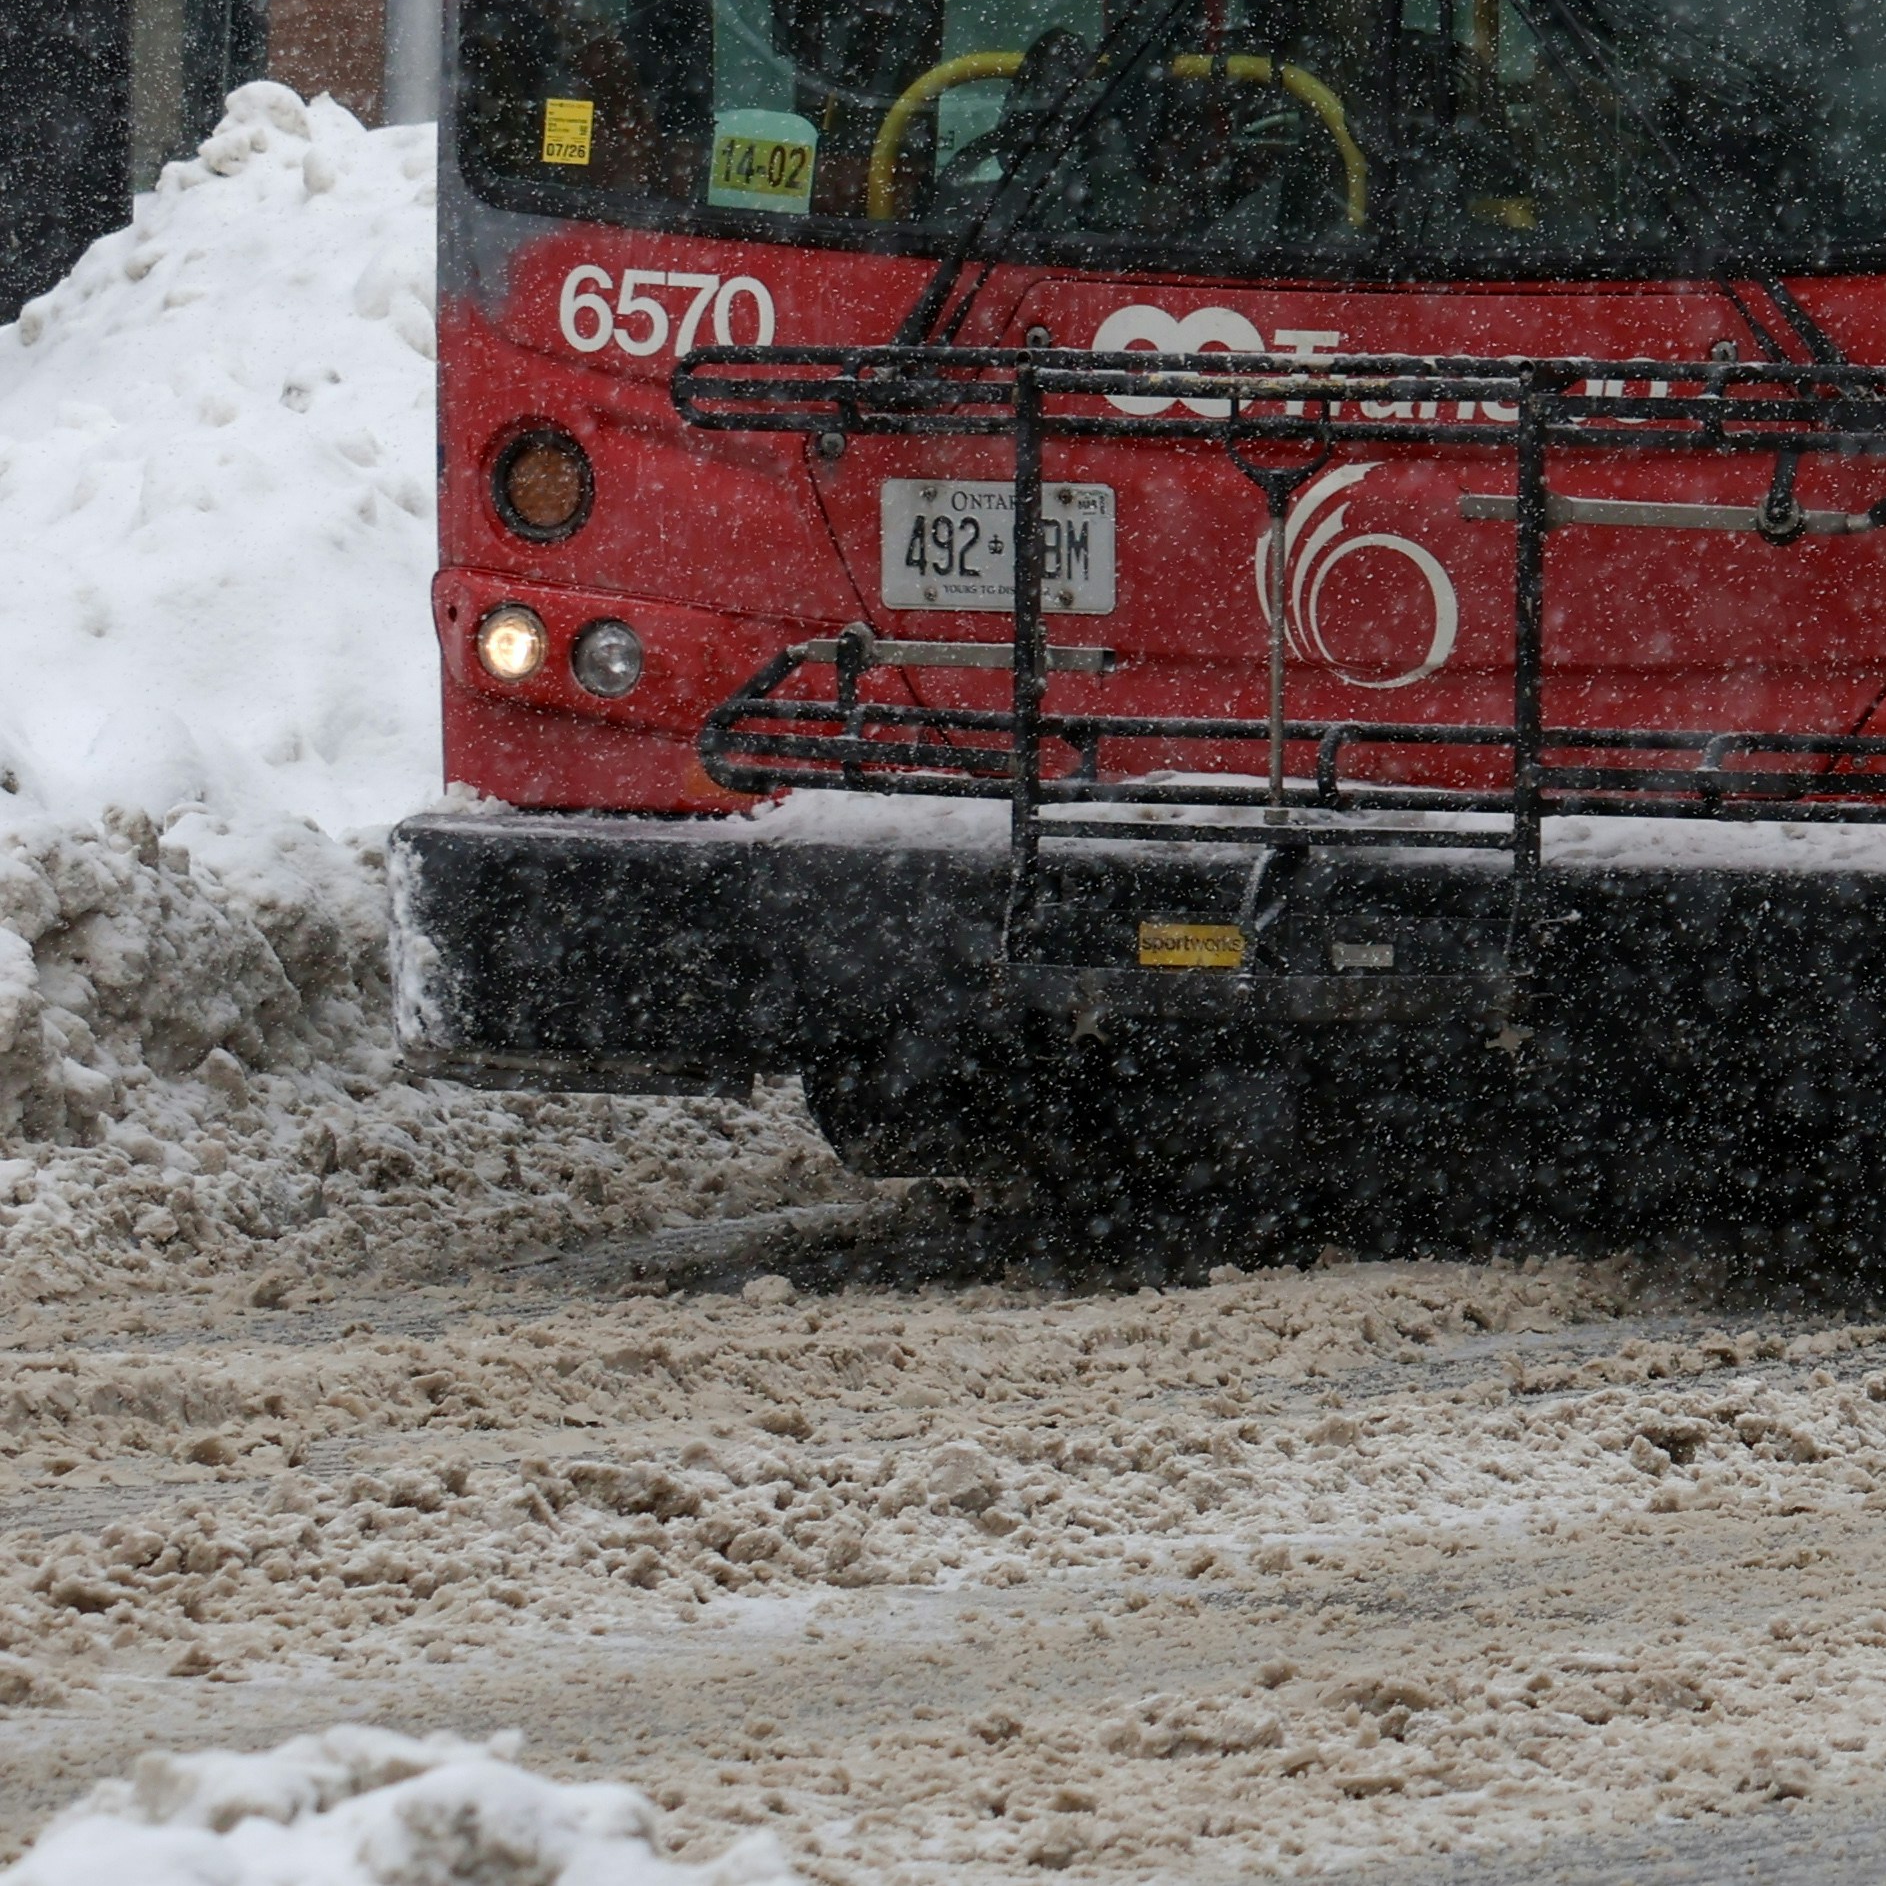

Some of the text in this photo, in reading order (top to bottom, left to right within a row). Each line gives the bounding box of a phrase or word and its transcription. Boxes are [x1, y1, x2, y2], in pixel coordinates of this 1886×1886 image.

[546, 143, 586, 159] 07/26
[721, 138, 807, 192] 14-02
[559, 265, 776, 358] 6570
[951, 491, 1018, 512] ONTA
[905, 515, 1090, 581] 492 BM
[1141, 933, 1243, 955] sportworks
